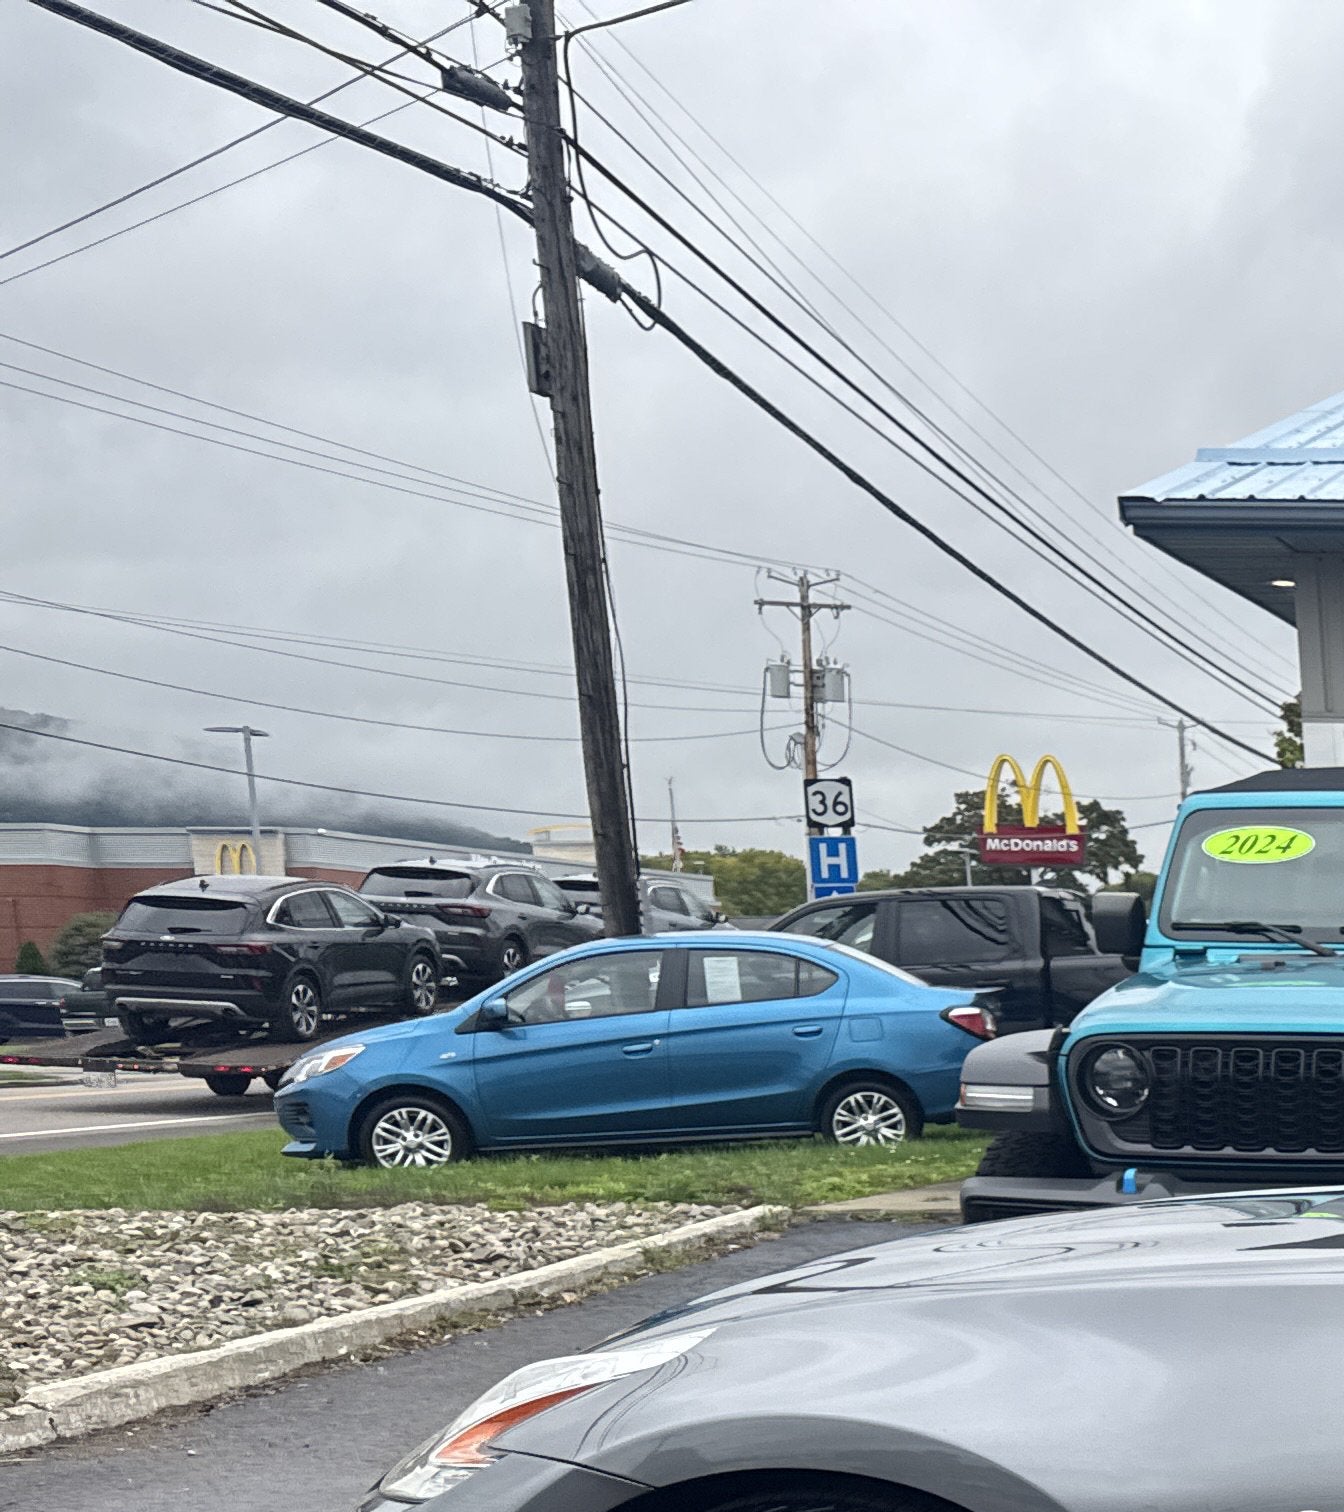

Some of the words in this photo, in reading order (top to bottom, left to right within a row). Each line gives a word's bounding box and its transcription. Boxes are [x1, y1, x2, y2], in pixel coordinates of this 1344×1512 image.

[811, 790, 849, 817] 36
[985, 838, 1079, 852] McDonald's
[1218, 834, 1299, 855] 2024
[818, 842, 849, 879] H
